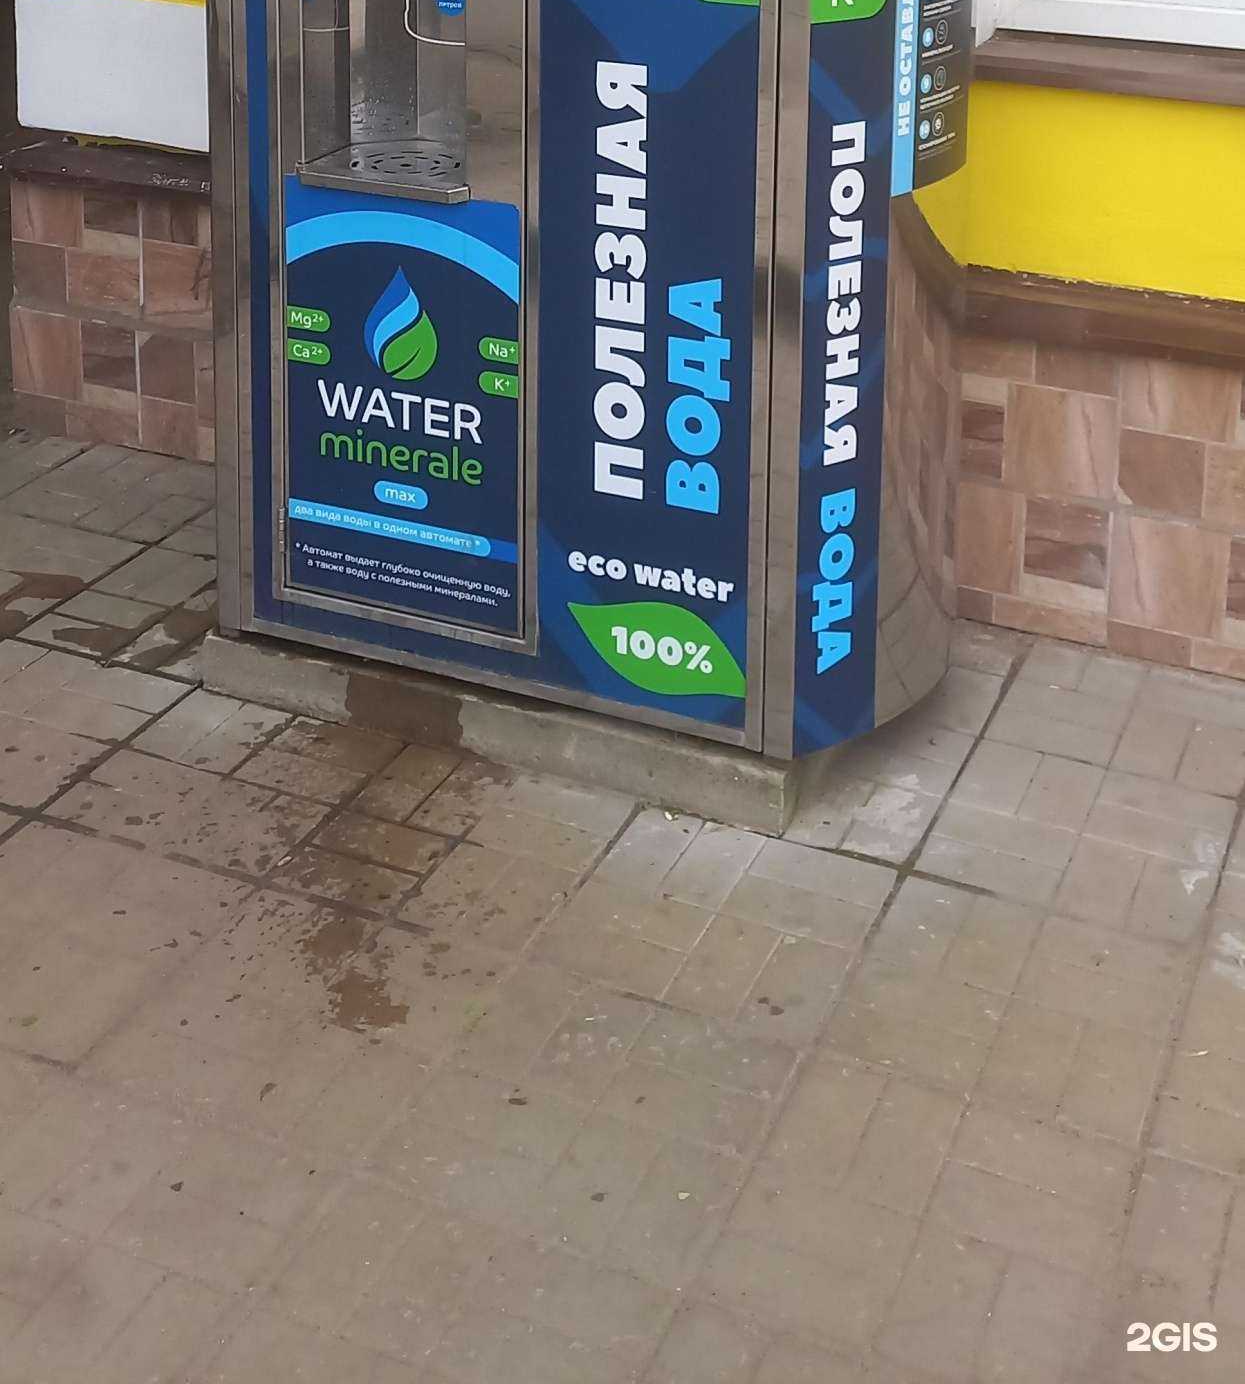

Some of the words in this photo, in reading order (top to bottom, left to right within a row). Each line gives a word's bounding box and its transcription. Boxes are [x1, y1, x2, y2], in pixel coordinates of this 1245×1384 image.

[898, 100, 910, 136] НЕ
[594, 60, 649, 501] ПОЛЕЗНАЯ
[824, 120, 866, 466] ПОЛЕЗНАЯ
[317, 379, 483, 444] WATER
[666, 278, 731, 514] ВОДА
[320, 429, 483, 485] minerale
[385, 487, 416, 503] max
[295, 506, 313, 515] два
[316, 509, 341, 521] вида
[344, 514, 372, 528] воды
[383, 522, 417, 537] одном
[420, 530, 472, 548] автомате
[302, 545, 343, 559] Автомат
[345, 553, 379, 567] выдает
[381, 561, 420, 577] глубоко
[423, 570, 481, 590] очищенную
[484, 584, 510, 597] воду,
[315, 559, 343, 573] также
[346, 568, 369, 580] воду
[378, 574, 432, 591] полезными
[434, 586, 498, 606] минералами.
[567, 549, 627, 581] eco
[634, 559, 735, 602] water
[812, 487, 855, 675] ВОДА
[611, 625, 713, 674] 100%
